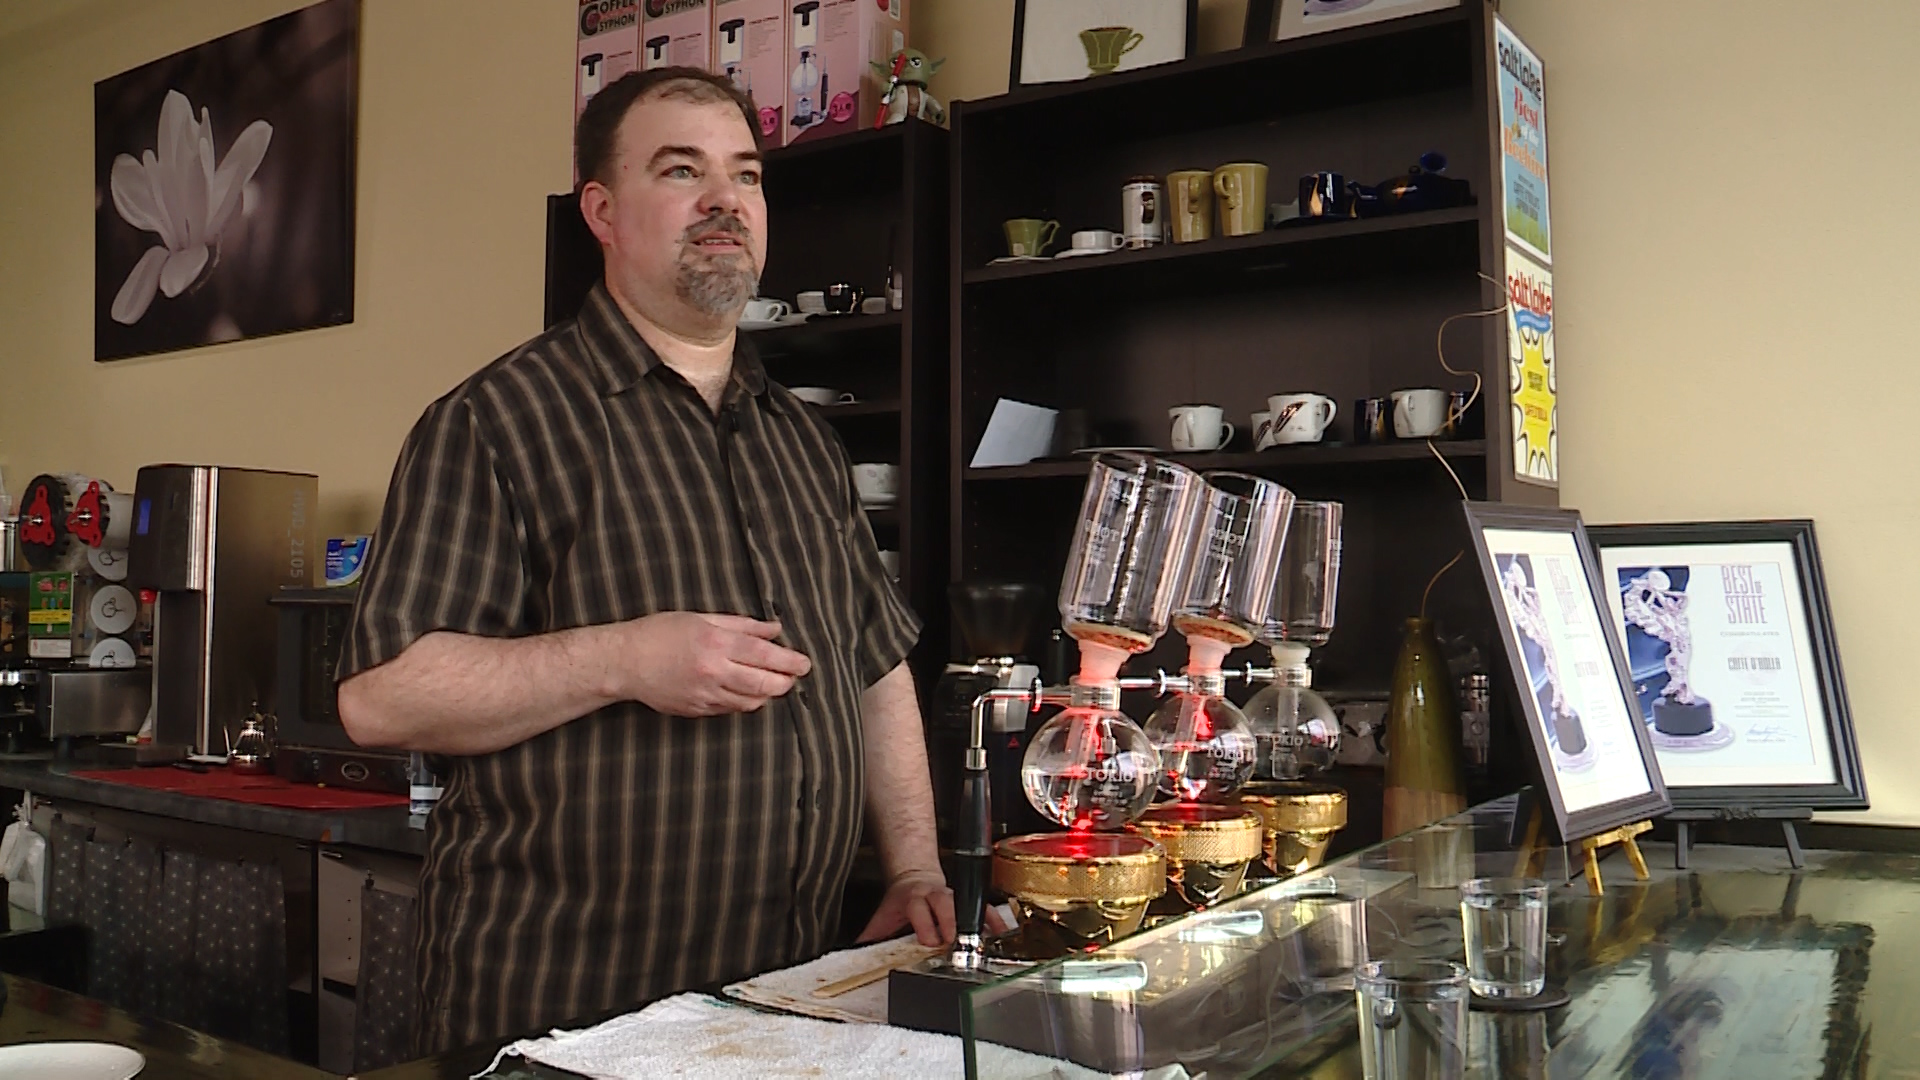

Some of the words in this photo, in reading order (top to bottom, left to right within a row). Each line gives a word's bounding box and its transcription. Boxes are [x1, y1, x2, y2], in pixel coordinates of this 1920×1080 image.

[599, 14, 636, 32] SYPHON
[1514, 86, 1538, 130] Best
[1721, 565, 1753, 594] BEST
[1725, 595, 1768, 624] STATE
[1084, 767, 1134, 782] TOKIO
